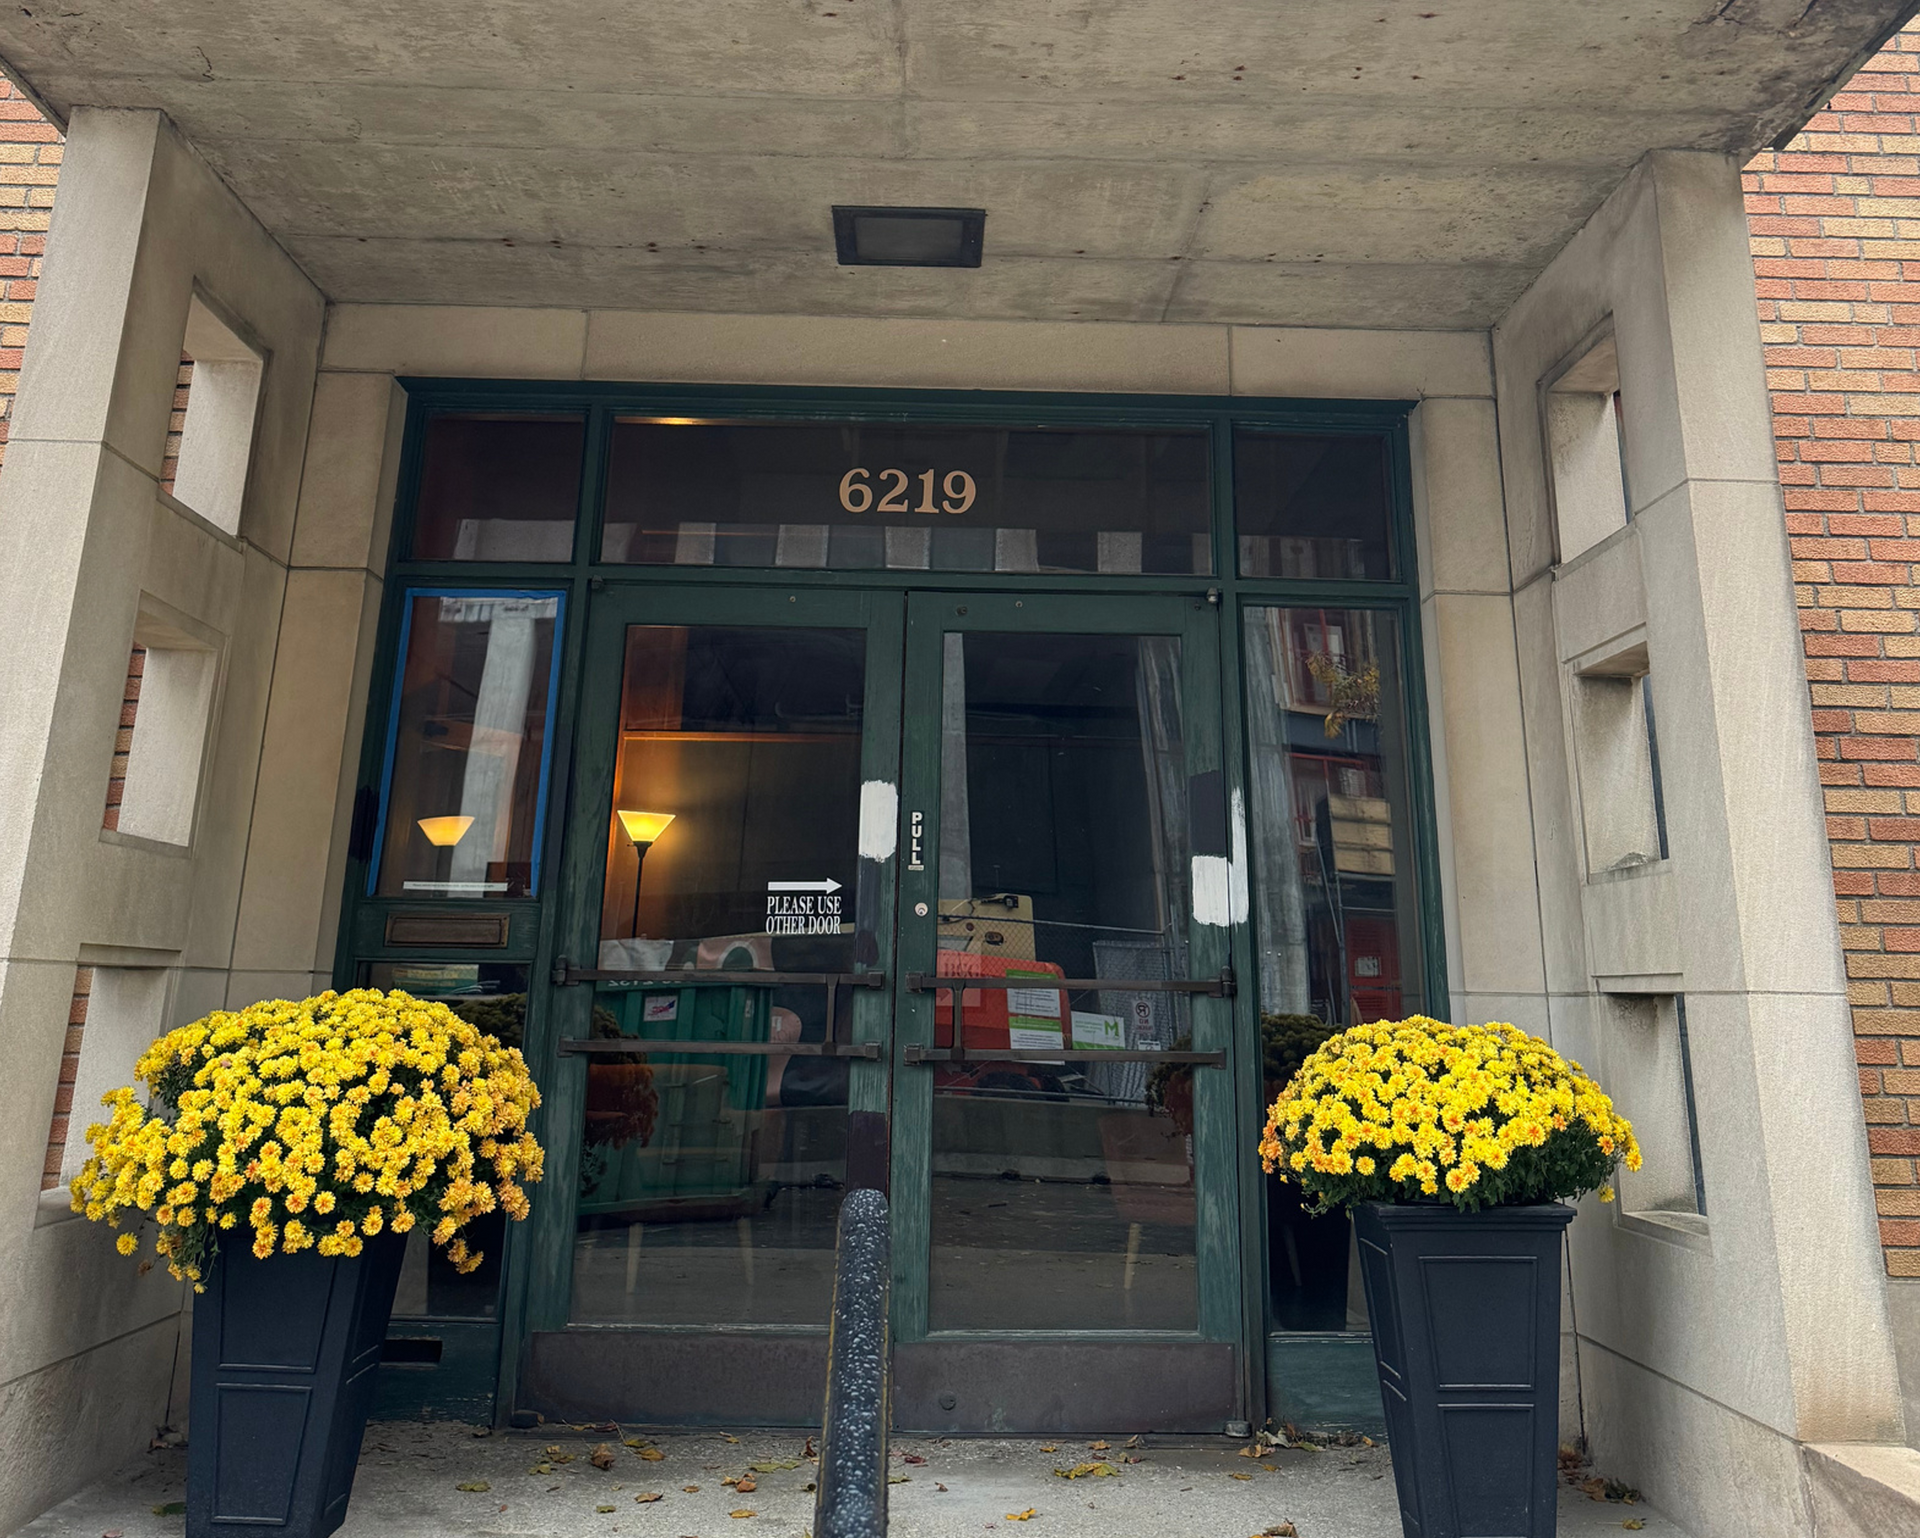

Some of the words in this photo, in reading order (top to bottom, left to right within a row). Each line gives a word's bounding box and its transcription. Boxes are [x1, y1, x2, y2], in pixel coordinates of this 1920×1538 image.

[839, 467, 977, 514] 6219
[911, 811, 923, 865] PULL
[766, 895, 815, 915] PLEASE
[817, 895, 842, 915] USE
[765, 915, 806, 935] OTHER
[808, 915, 841, 935] DOOR
